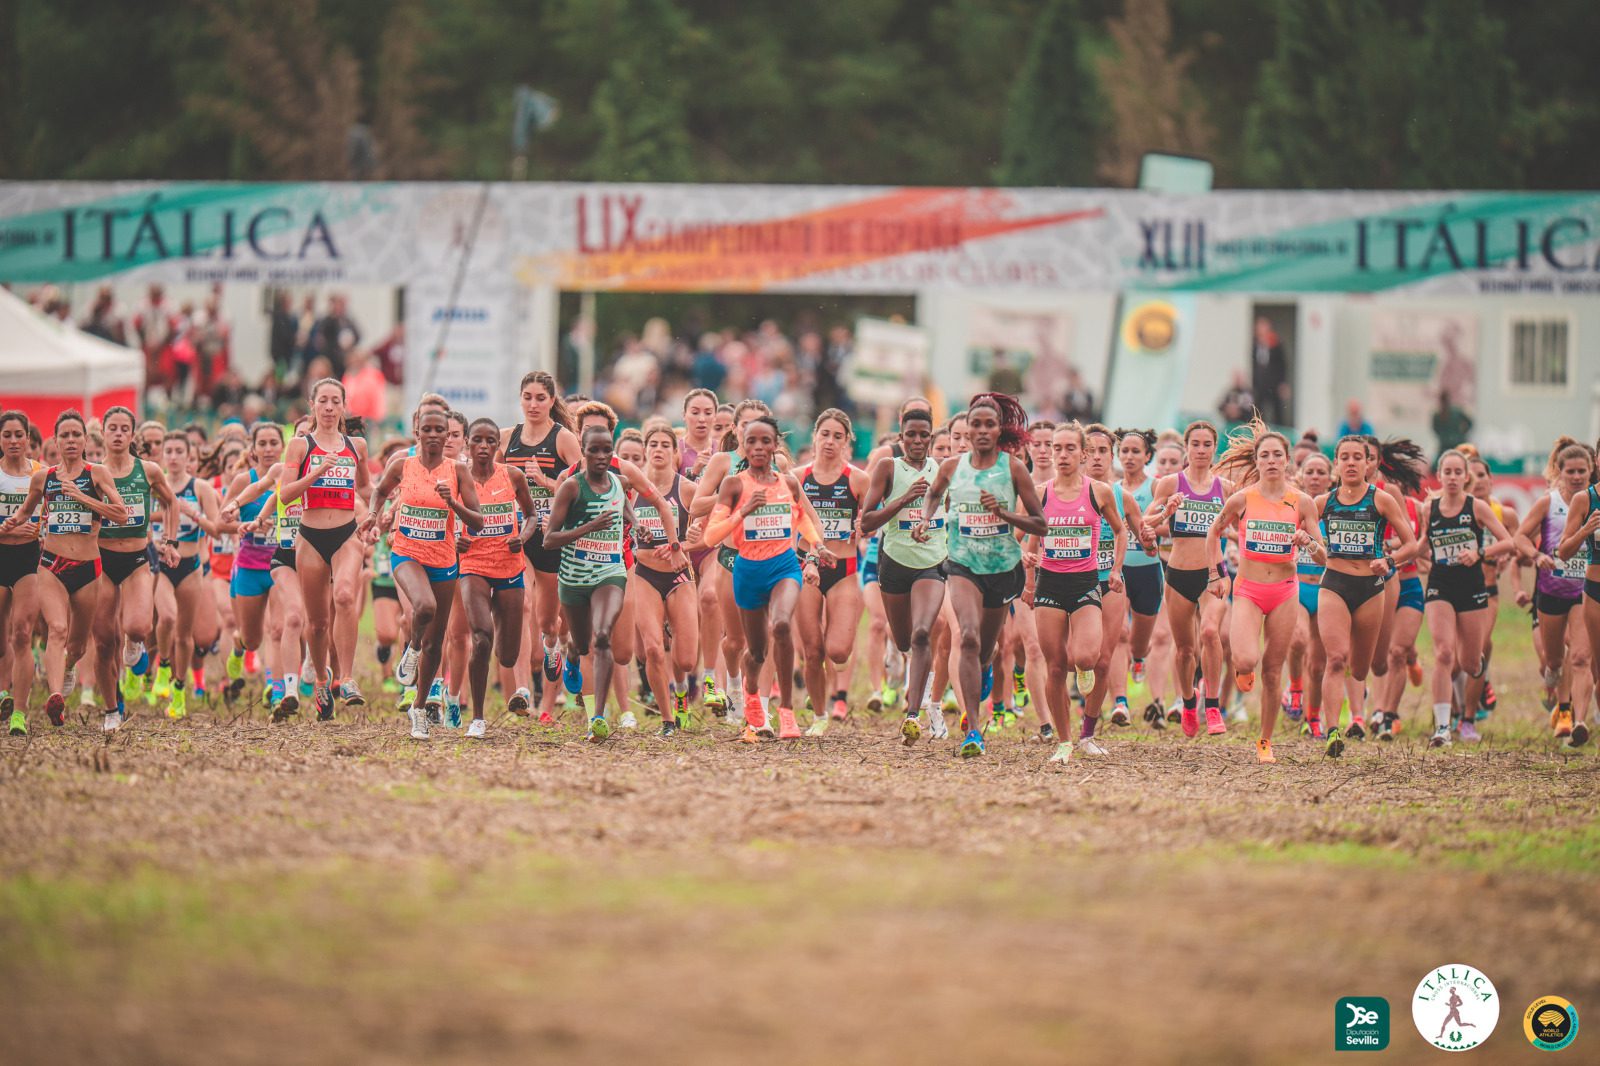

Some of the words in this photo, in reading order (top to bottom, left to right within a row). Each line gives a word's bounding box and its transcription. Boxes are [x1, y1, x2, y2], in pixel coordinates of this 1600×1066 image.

[62, 193, 340, 262] ITÁLICA
[577, 193, 643, 254] LIX
[57, 513, 81, 524] 823
[755, 516, 783, 527] CHEBET
[1047, 516, 1085, 525] BIKILA
[1184, 512, 1215, 524] 1098
[1054, 538, 1080, 548] PRIETO
[1252, 531, 1289, 543] GALLARDO
[1336, 532, 1367, 544] 1643
